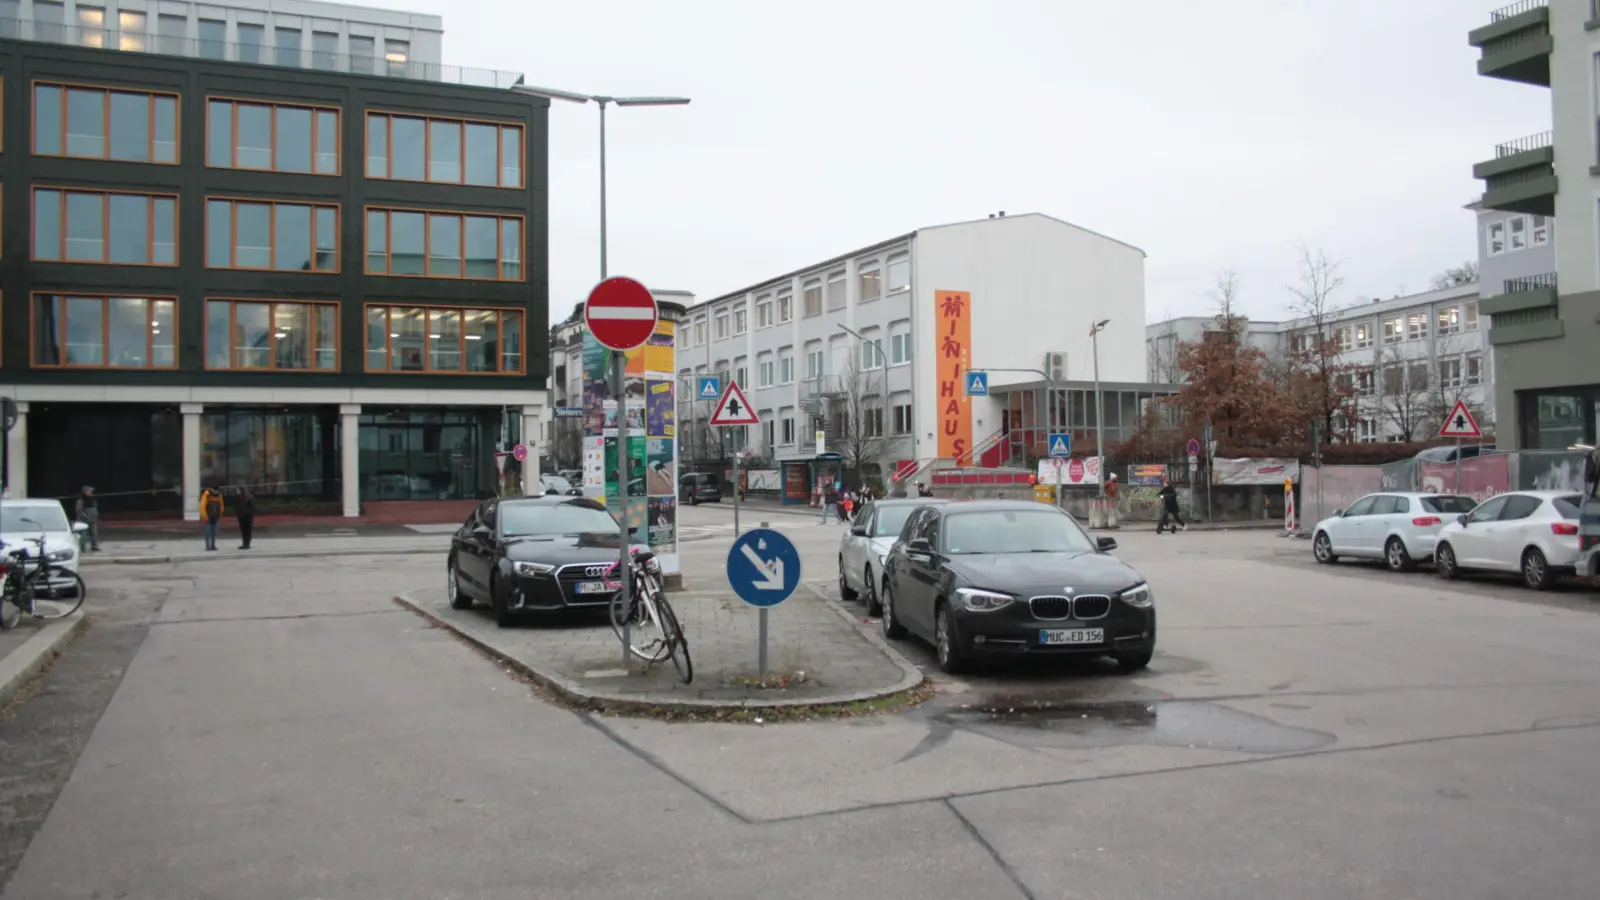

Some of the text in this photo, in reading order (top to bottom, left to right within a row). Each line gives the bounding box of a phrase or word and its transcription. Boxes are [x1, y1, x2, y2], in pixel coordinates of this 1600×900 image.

[592, 583, 602, 592] JA
[1047, 630, 1102, 642] MUC ED 156
